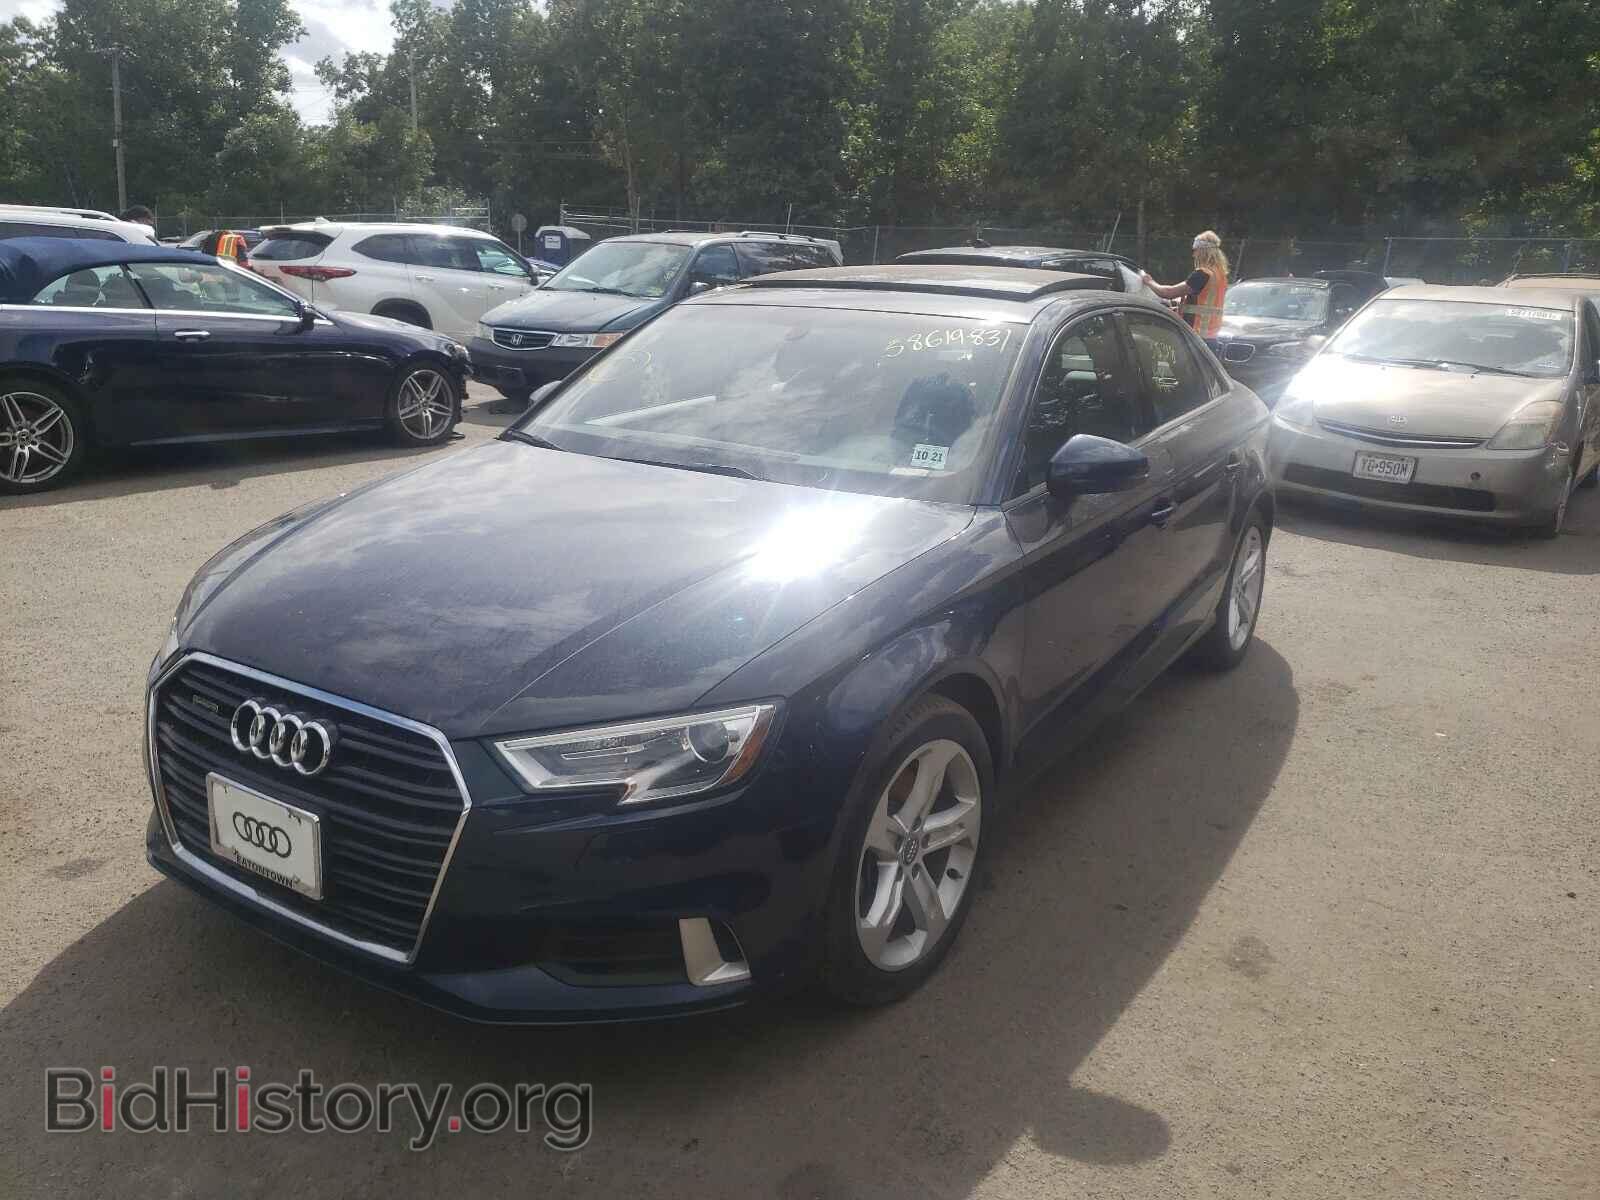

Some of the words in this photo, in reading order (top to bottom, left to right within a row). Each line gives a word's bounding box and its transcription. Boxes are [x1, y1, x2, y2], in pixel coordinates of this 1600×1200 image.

[886, 328, 1011, 358] 58619831
[914, 450, 928, 460] 10
[930, 451, 942, 462] 21
[235, 853, 294, 889] EATONTOWN
